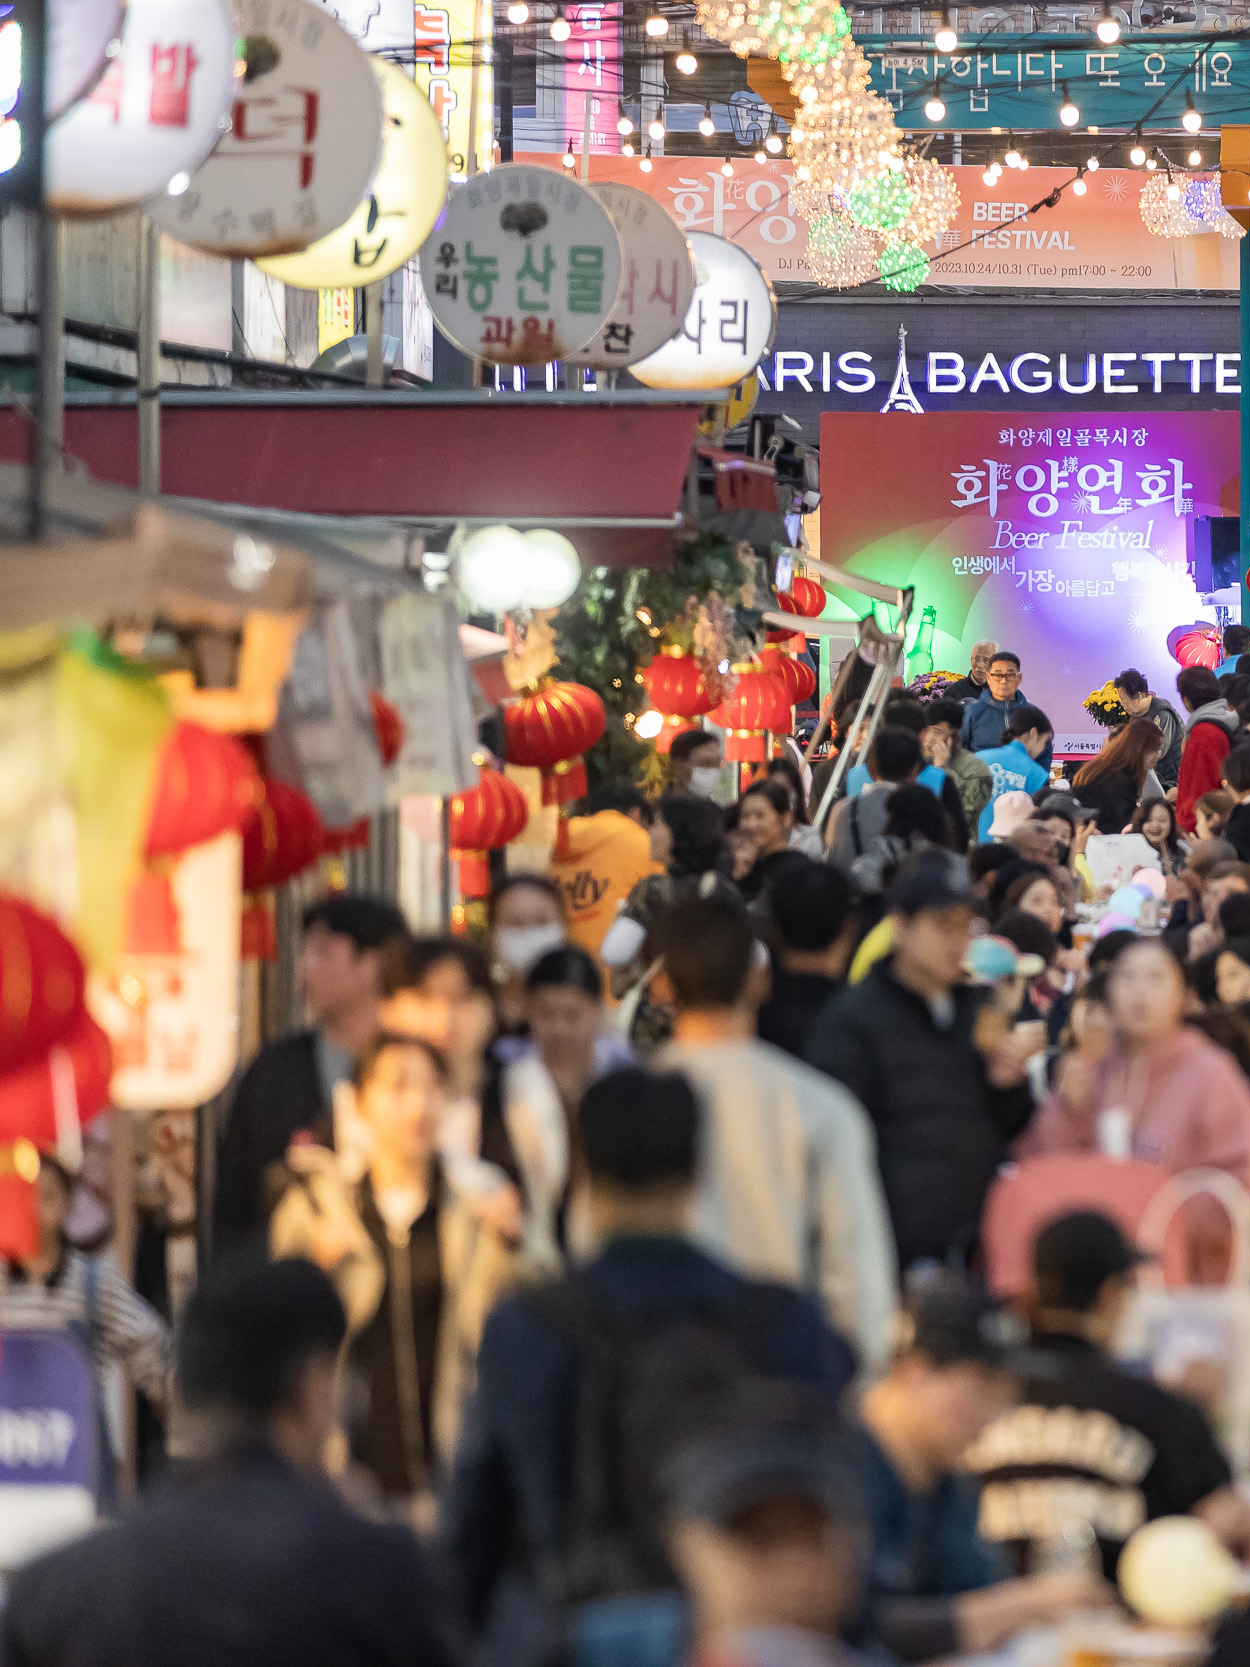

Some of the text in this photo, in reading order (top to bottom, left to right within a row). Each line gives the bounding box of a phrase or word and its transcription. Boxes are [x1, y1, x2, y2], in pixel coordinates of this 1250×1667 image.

[1086, 52, 1120, 88] 또
[973, 201, 1029, 222] BEER
[971, 229, 1076, 250] FESTIVAL
[435, 241, 459, 300] 우리
[462, 241, 605, 314] 농산물
[778, 258, 792, 270] DJ
[934, 262, 1023, 275] 2023.10.24/10.31
[1026, 263, 1057, 277] (Tue)
[1061, 264, 1106, 279] pm17:00
[1121, 265, 1152, 277] 22:00
[928, 351, 1241, 394] BAGUETTE
[998, 426, 1149, 447] 화양제일골목시장
[950, 458, 1193, 518] 화양연화
[989, 518, 1154, 549] Beer Festival
[951, 555, 1016, 575] 인생에서
[1014, 568, 1055, 593] 가장
[1055, 579, 1116, 598] 아름답고
